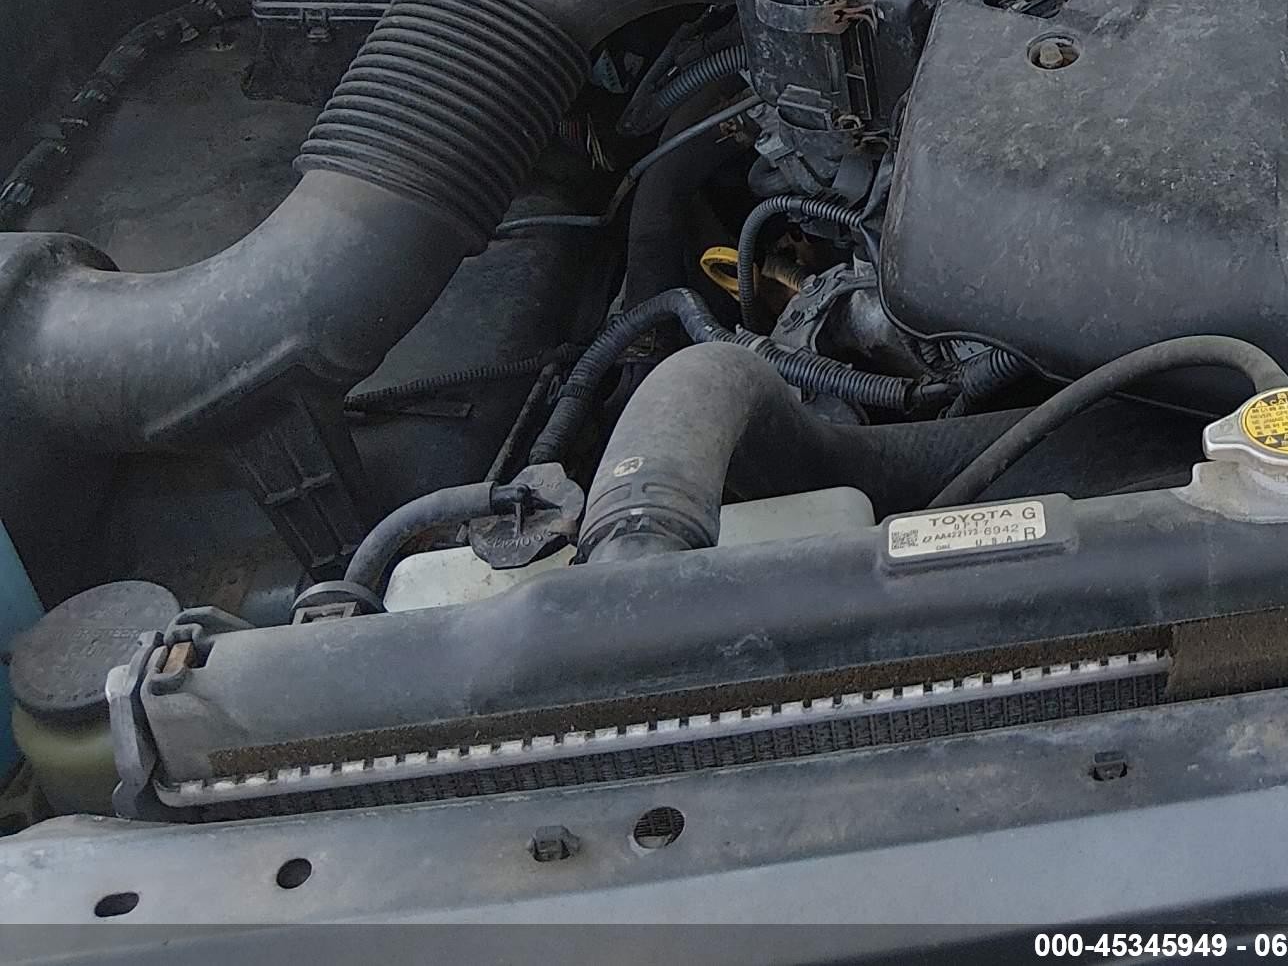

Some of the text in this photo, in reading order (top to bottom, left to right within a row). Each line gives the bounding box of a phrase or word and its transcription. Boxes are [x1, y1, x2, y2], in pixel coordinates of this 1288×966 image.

[929, 507, 1036, 527] TOYOTA G
[1024, 526, 1036, 540] R
